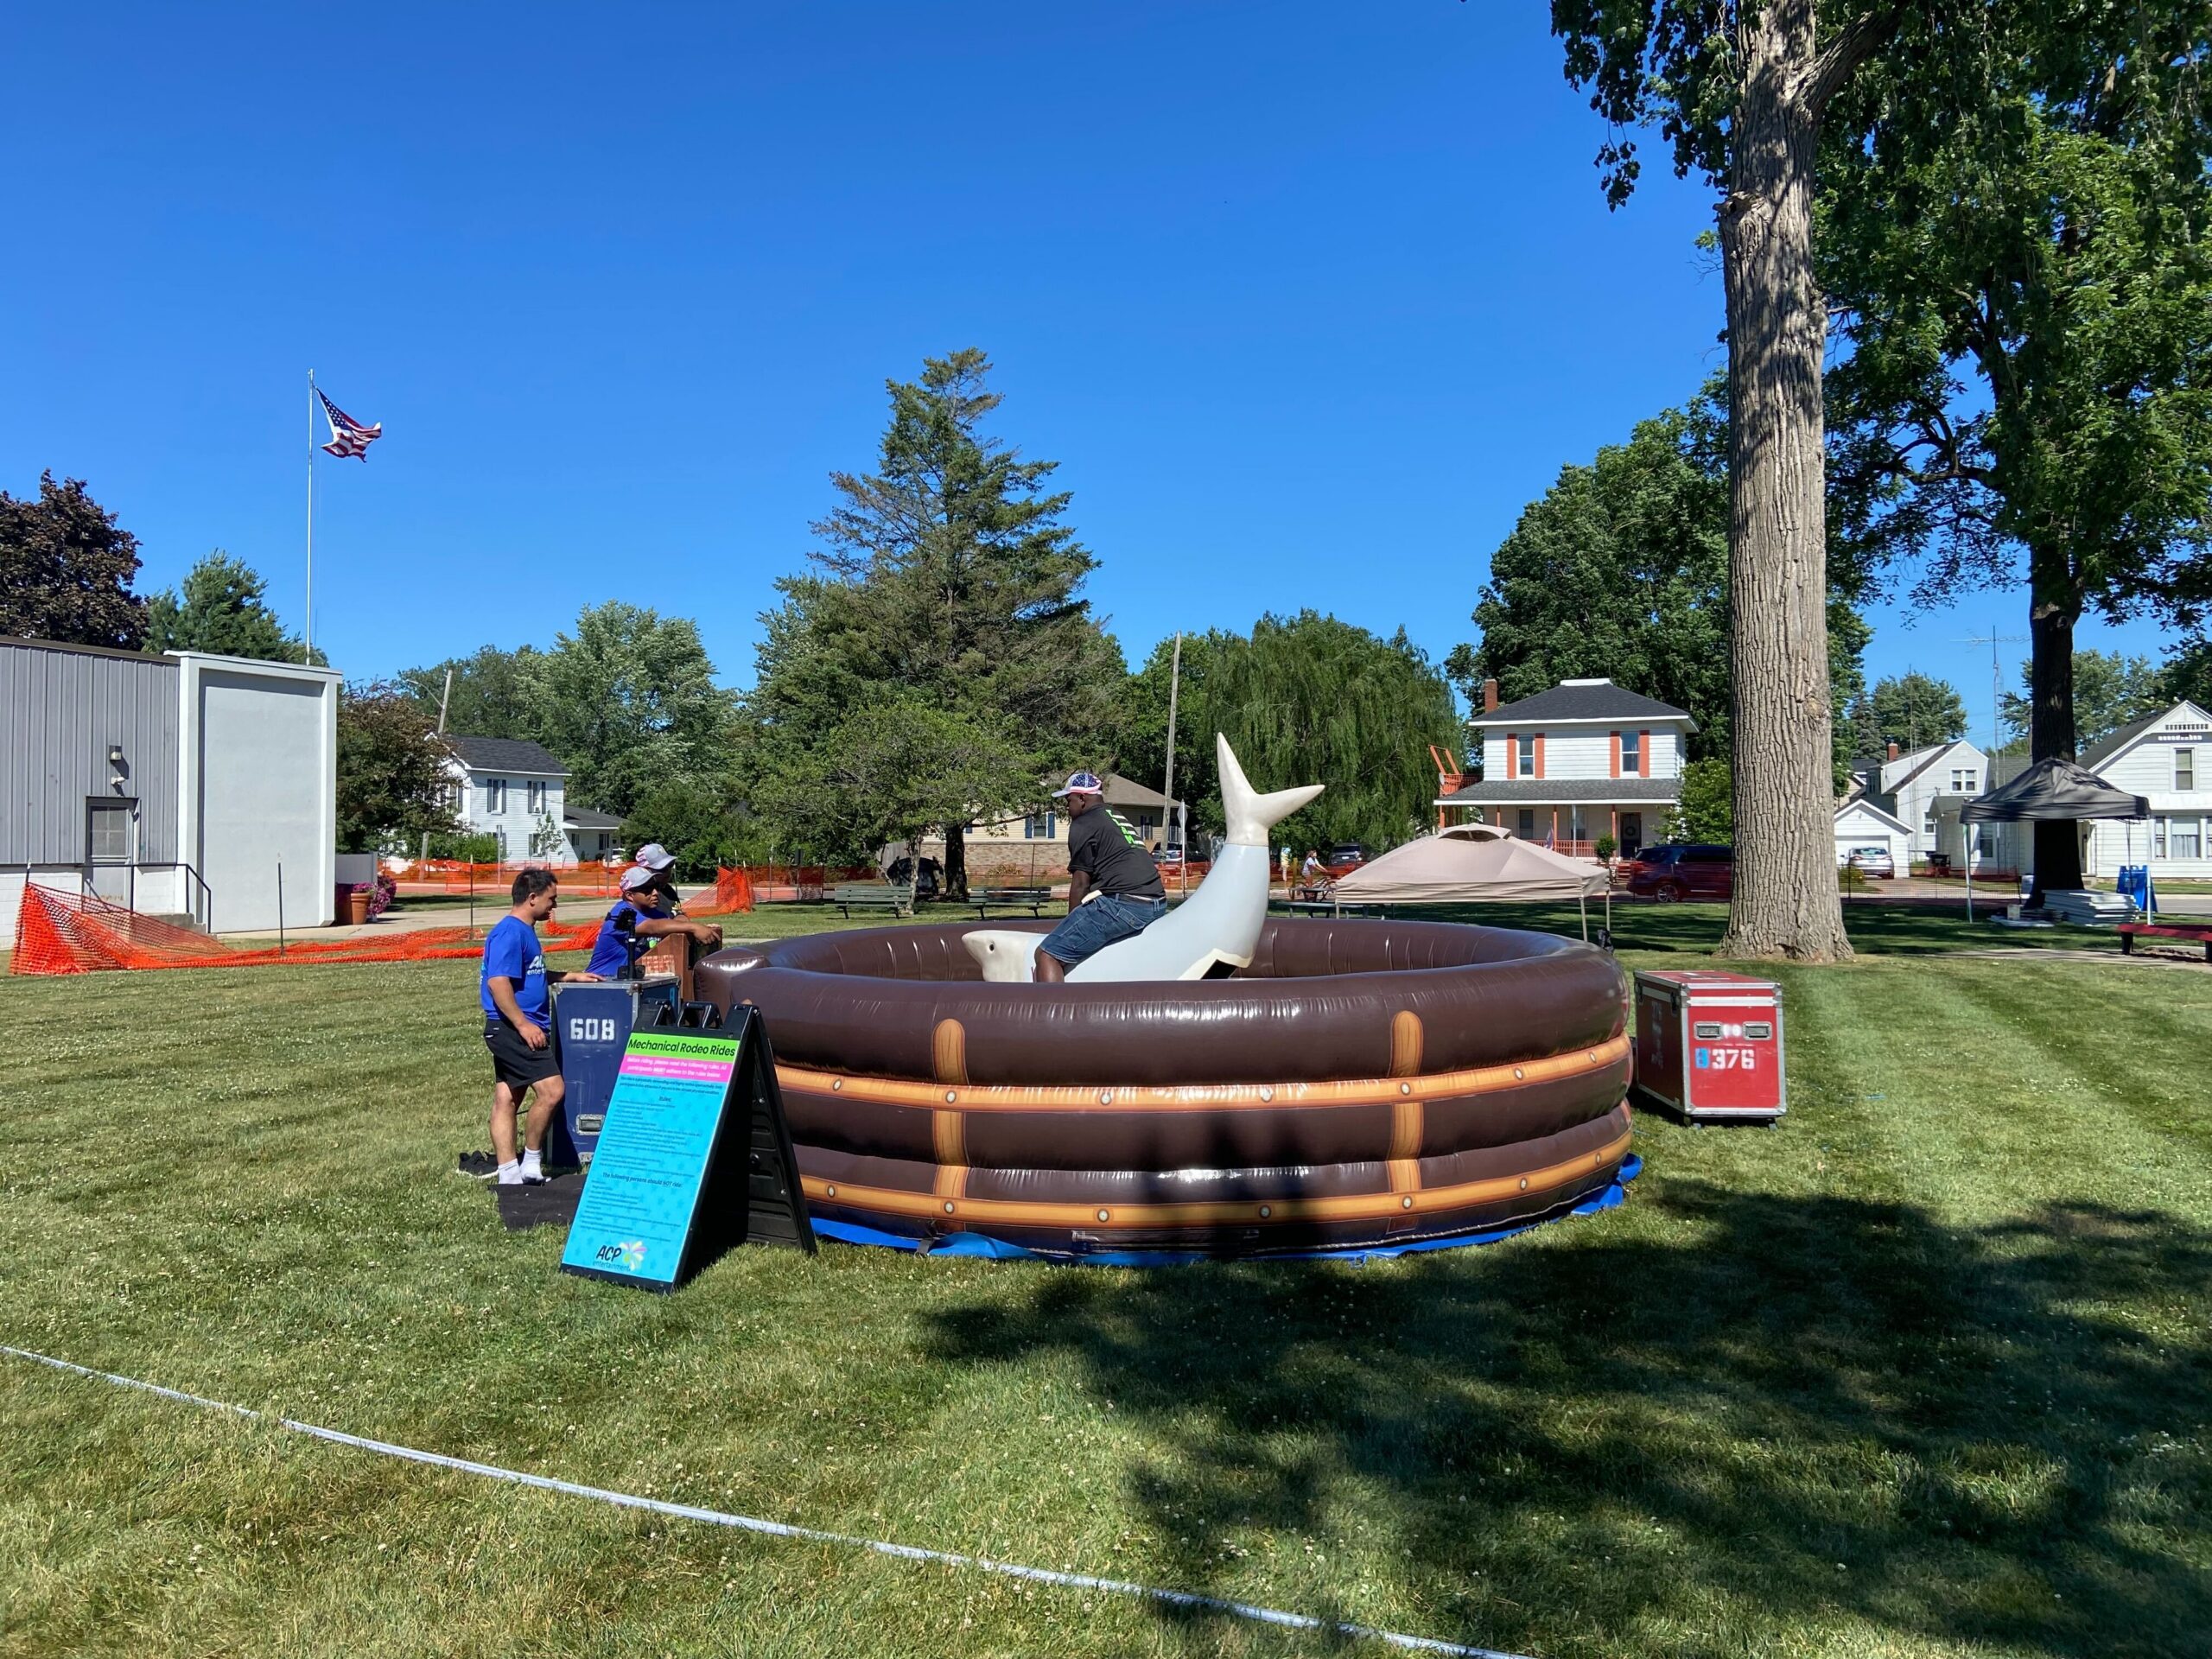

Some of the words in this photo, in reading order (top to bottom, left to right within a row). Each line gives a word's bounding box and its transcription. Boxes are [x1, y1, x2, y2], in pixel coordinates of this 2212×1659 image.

[570, 1018, 615, 1040] 608
[628, 1039, 679, 1052] Mechanical
[680, 1043, 709, 1055] Rodeo
[709, 1044, 736, 1057] Rides
[596, 1244, 622, 1262] ACP
[593, 1260, 631, 1272] entertainment
